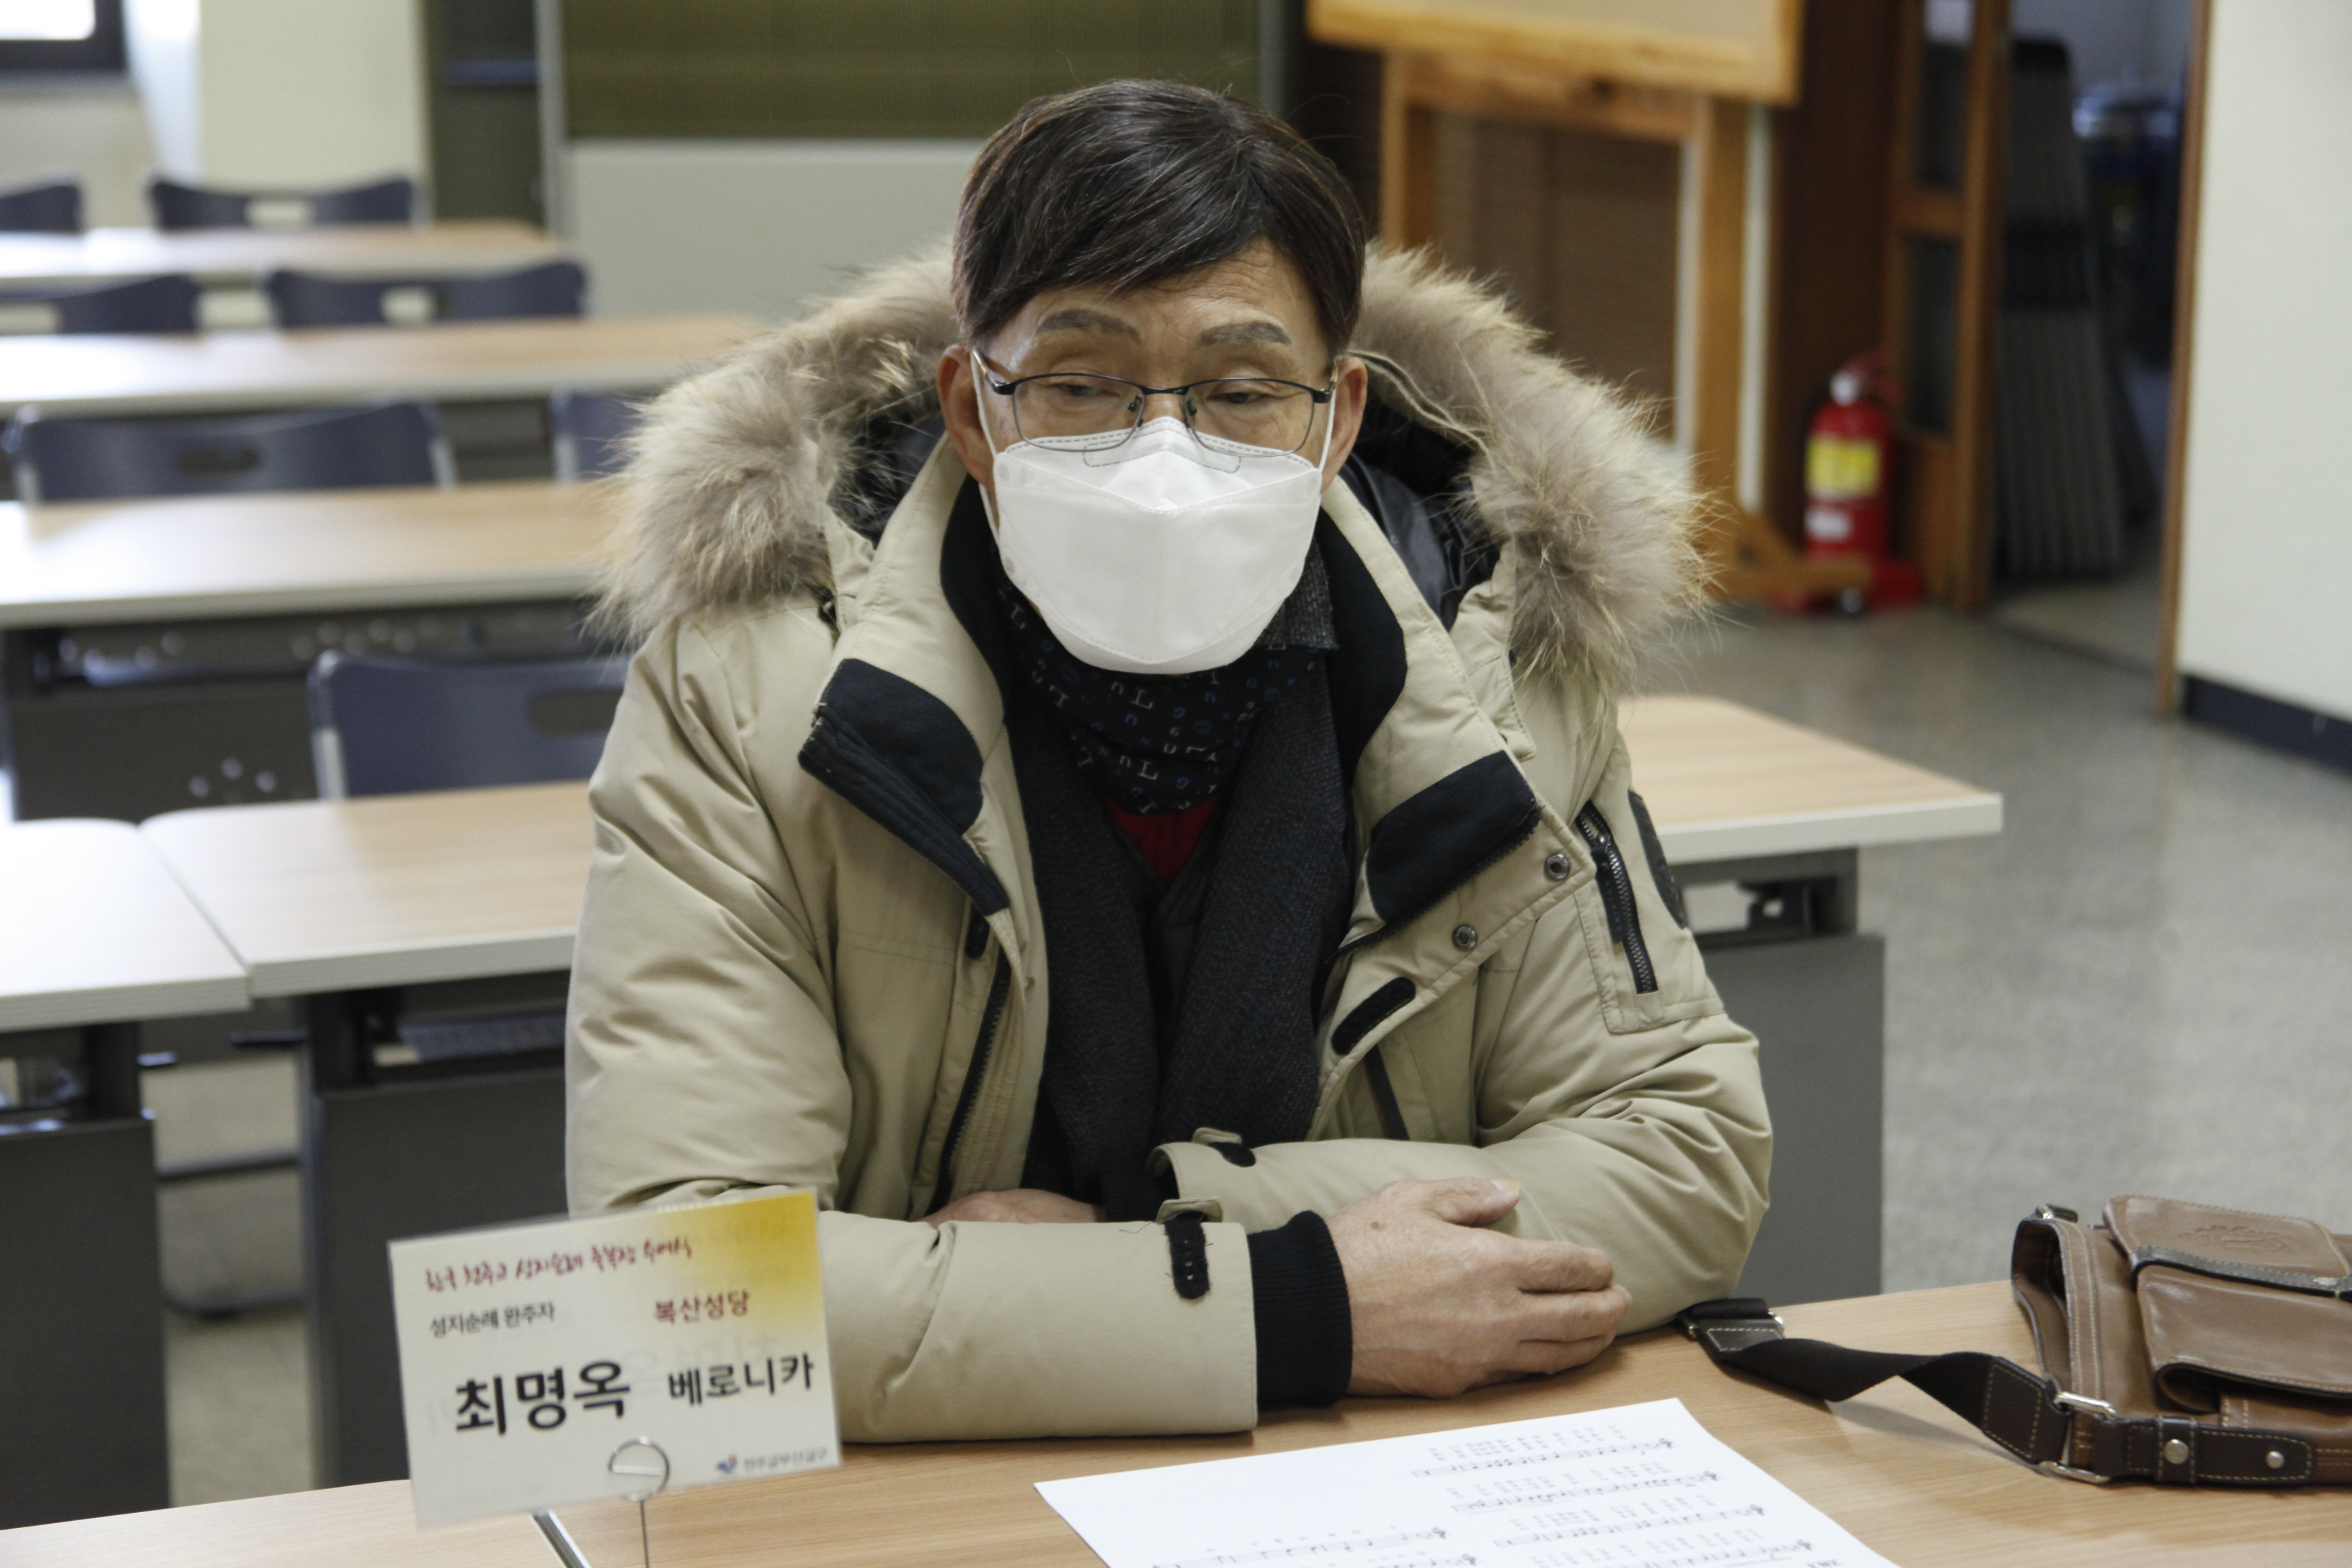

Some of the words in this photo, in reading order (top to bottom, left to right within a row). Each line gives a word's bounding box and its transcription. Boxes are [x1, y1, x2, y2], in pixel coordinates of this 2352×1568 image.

[516, 1252, 584, 1280] 성지순례
[430, 1307, 499, 1339] 성지순례
[503, 1301, 554, 1328] 완주자
[655, 1289, 749, 1325] 복산성당
[455, 1360, 632, 1436] 최명옥
[668, 1352, 814, 1406] 베로니카
